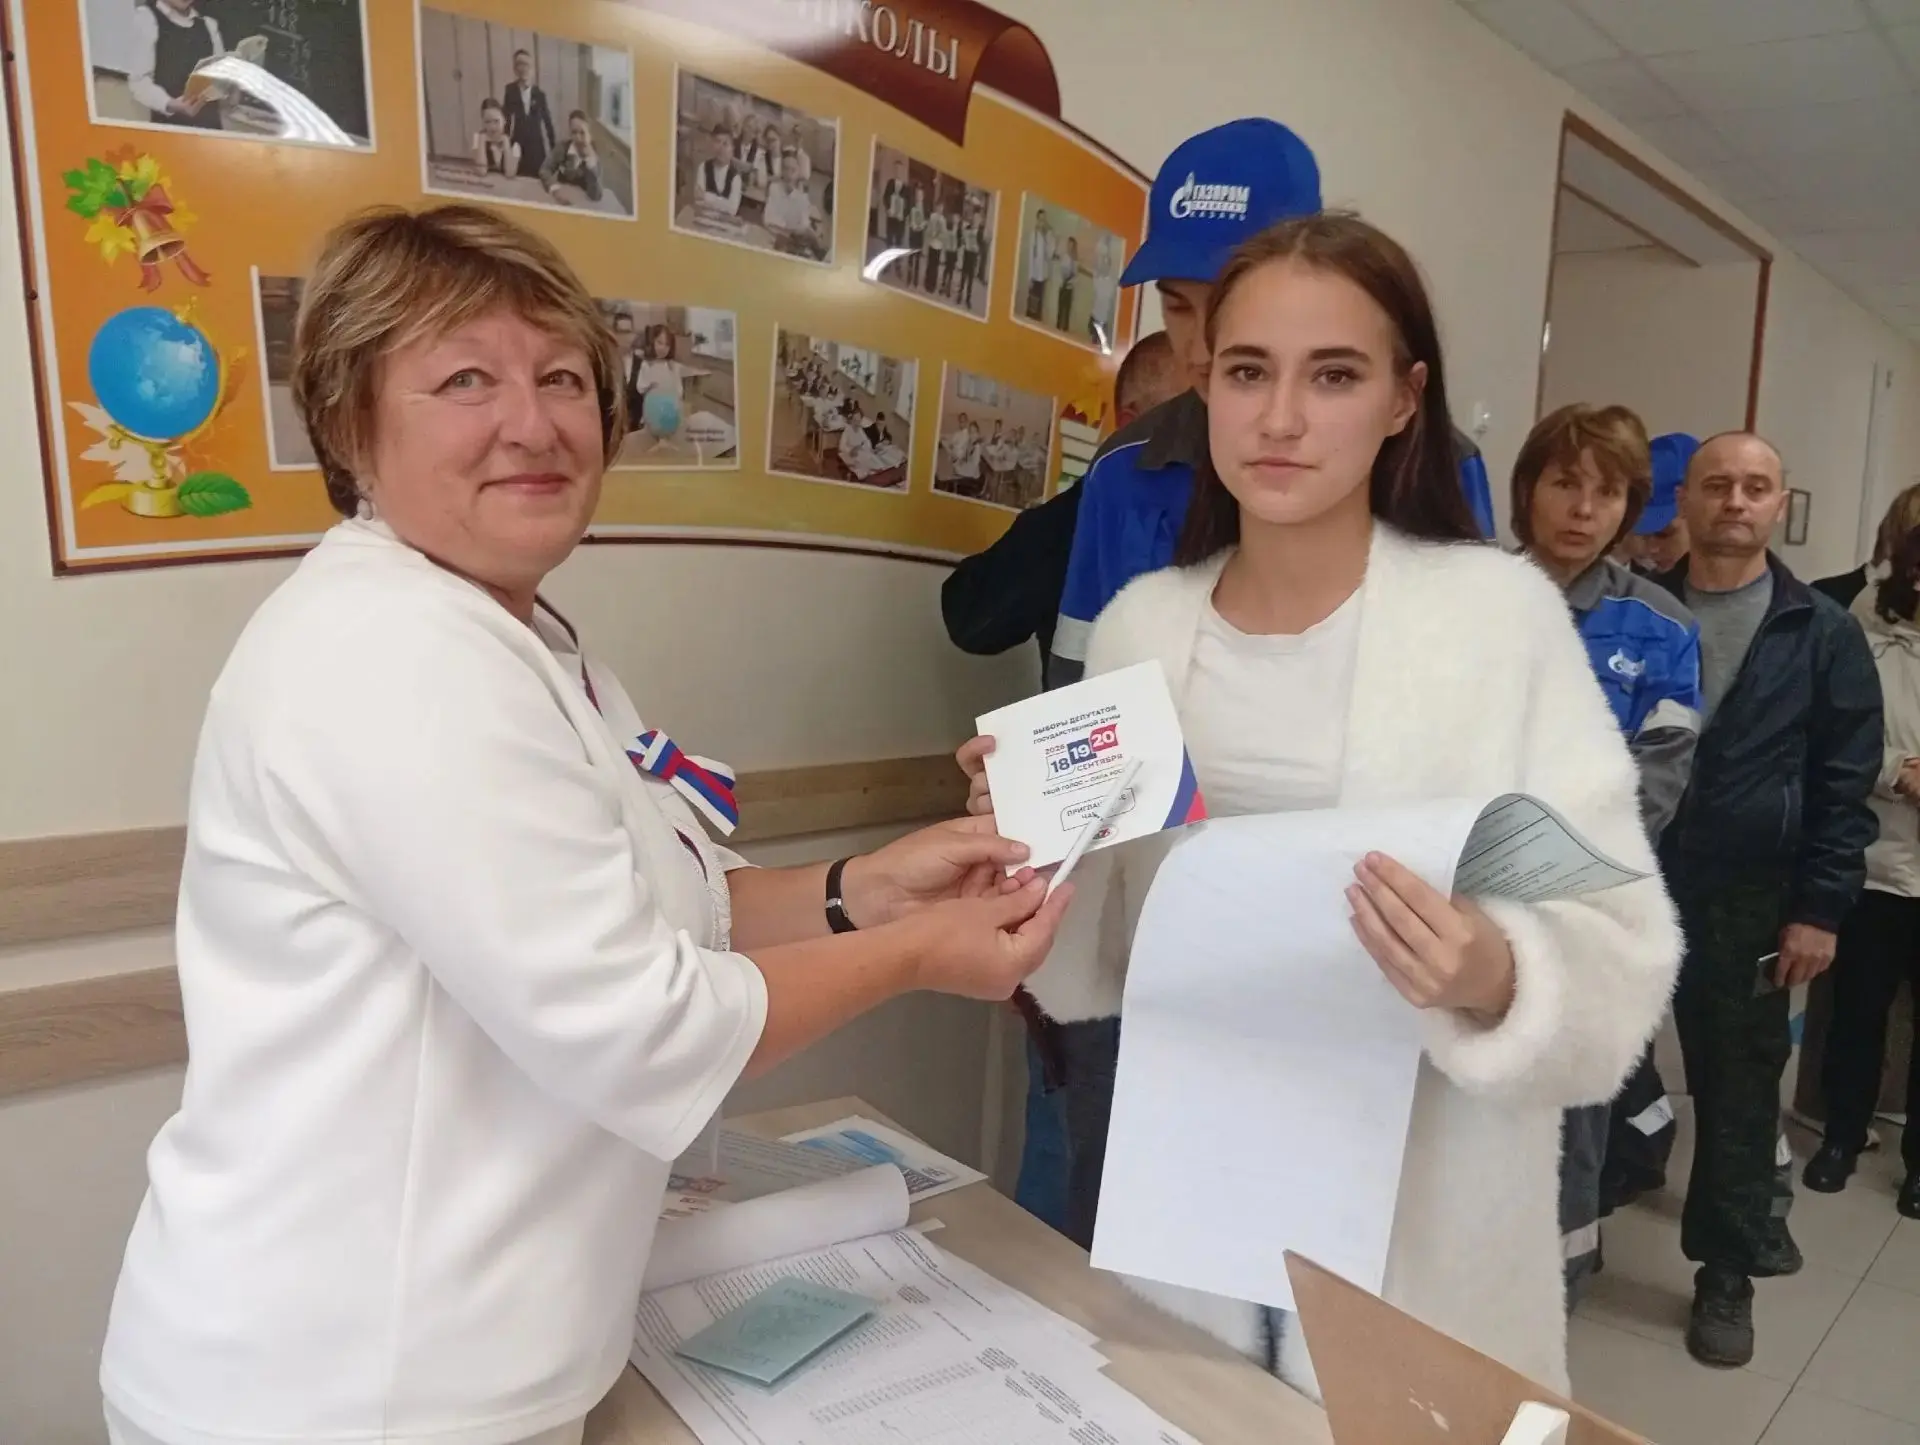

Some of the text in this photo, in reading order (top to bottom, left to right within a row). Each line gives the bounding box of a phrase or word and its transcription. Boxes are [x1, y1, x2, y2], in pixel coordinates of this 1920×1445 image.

[1193, 184, 1250, 203] ГАЗПРОМ
[1033, 704, 1117, 735] ВЫБОРЫ ДЕПУТАТОВ
[1033, 713, 1121, 745] ГОСУДАРСТВЕННОЙ ДУМЫ
[1045, 743, 1066, 755] 2026
[1050, 730, 1115, 773] 18 19 20
[1076, 753, 1123, 772] СЕНТЯБРЯ
[1061, 780, 1084, 791] ГОЛОС
[1066, 793, 1127, 817] ПРИГЛАЕ
